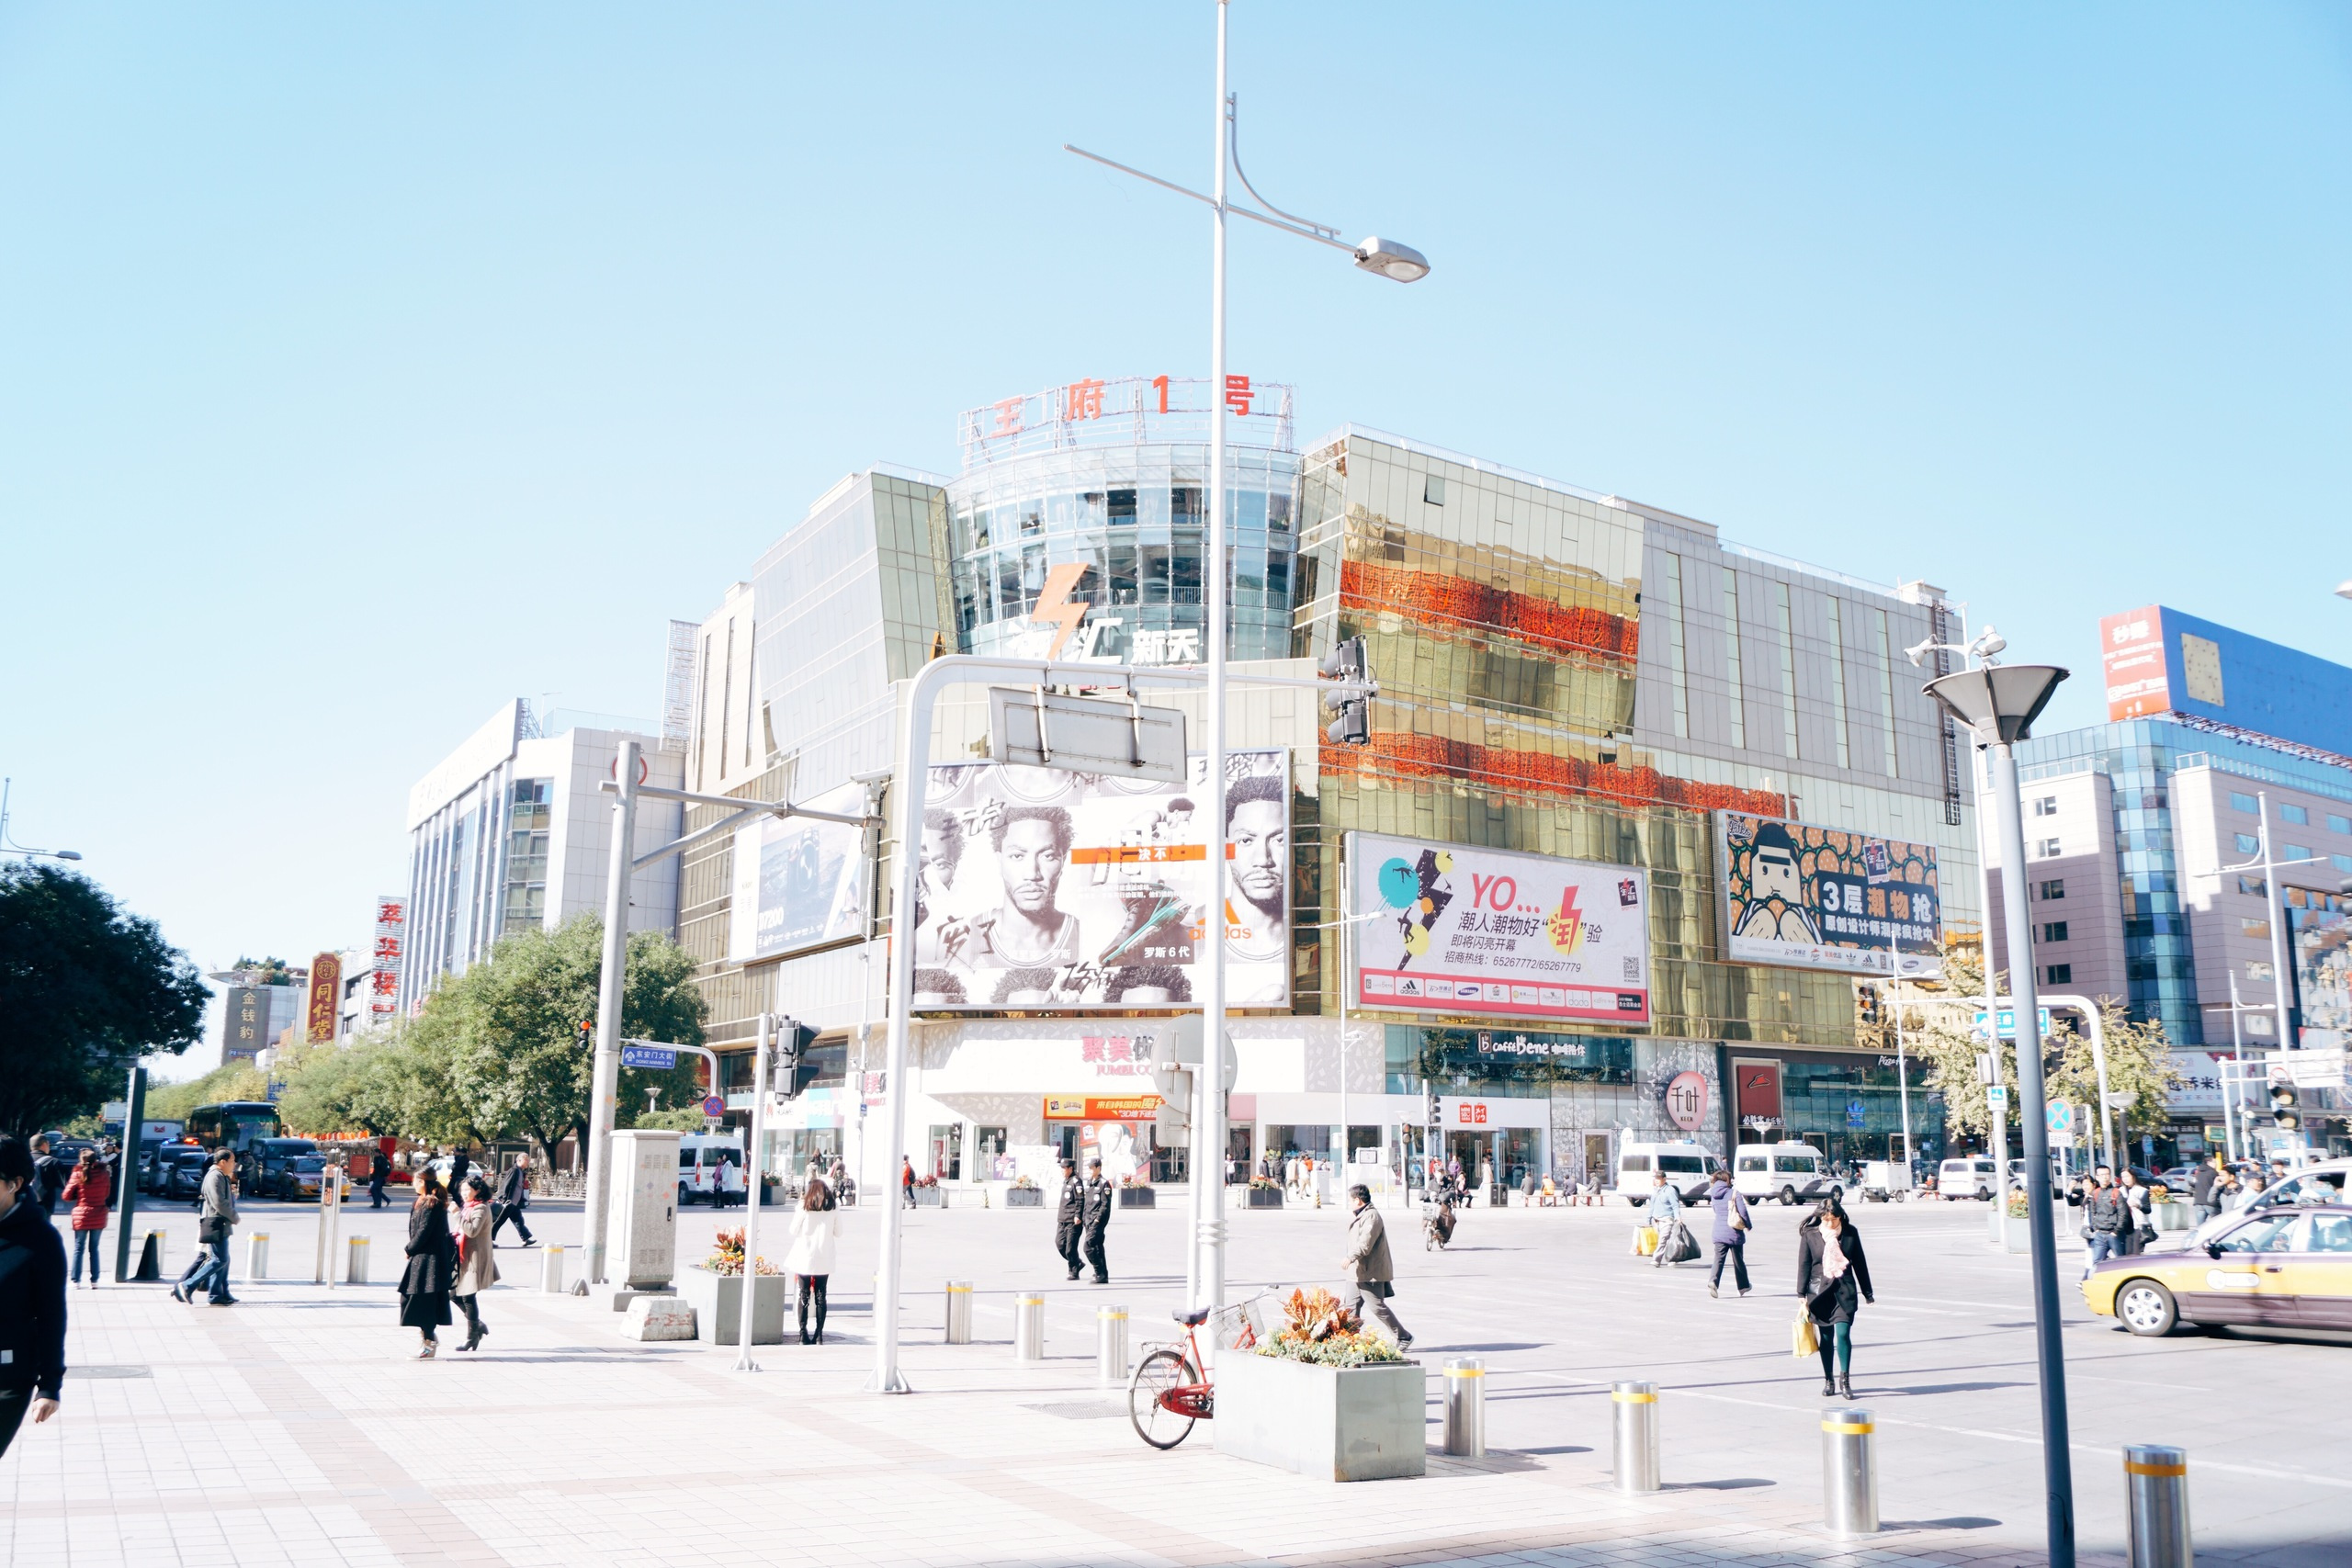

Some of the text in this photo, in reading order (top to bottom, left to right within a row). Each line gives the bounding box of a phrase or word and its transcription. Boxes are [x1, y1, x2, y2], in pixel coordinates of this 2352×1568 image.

[991, 375, 1255, 439] 王府1号
[1138, 847, 1167, 861] 决不
[1472, 873, 1541, 914] YO...
[1823, 881, 1933, 923] 3层潮物抢
[757, 906, 785, 931] D7200
[1825, 915, 1933, 942] 原创设计师潮牌疯抢中
[1188, 925, 1252, 941] addas
[1451, 933, 1517, 952] 即将闪亮开幕
[372, 903, 403, 997] 萃华楼
[238, 991, 256, 1040] 金钱豹
[311, 983, 333, 1040] 同仁堂
[636, 1050, 673, 1060] 东安门大街
[1080, 1035, 1155, 1063] 聚美优
[1878, 1055, 1909, 1066] Pizza Ht
